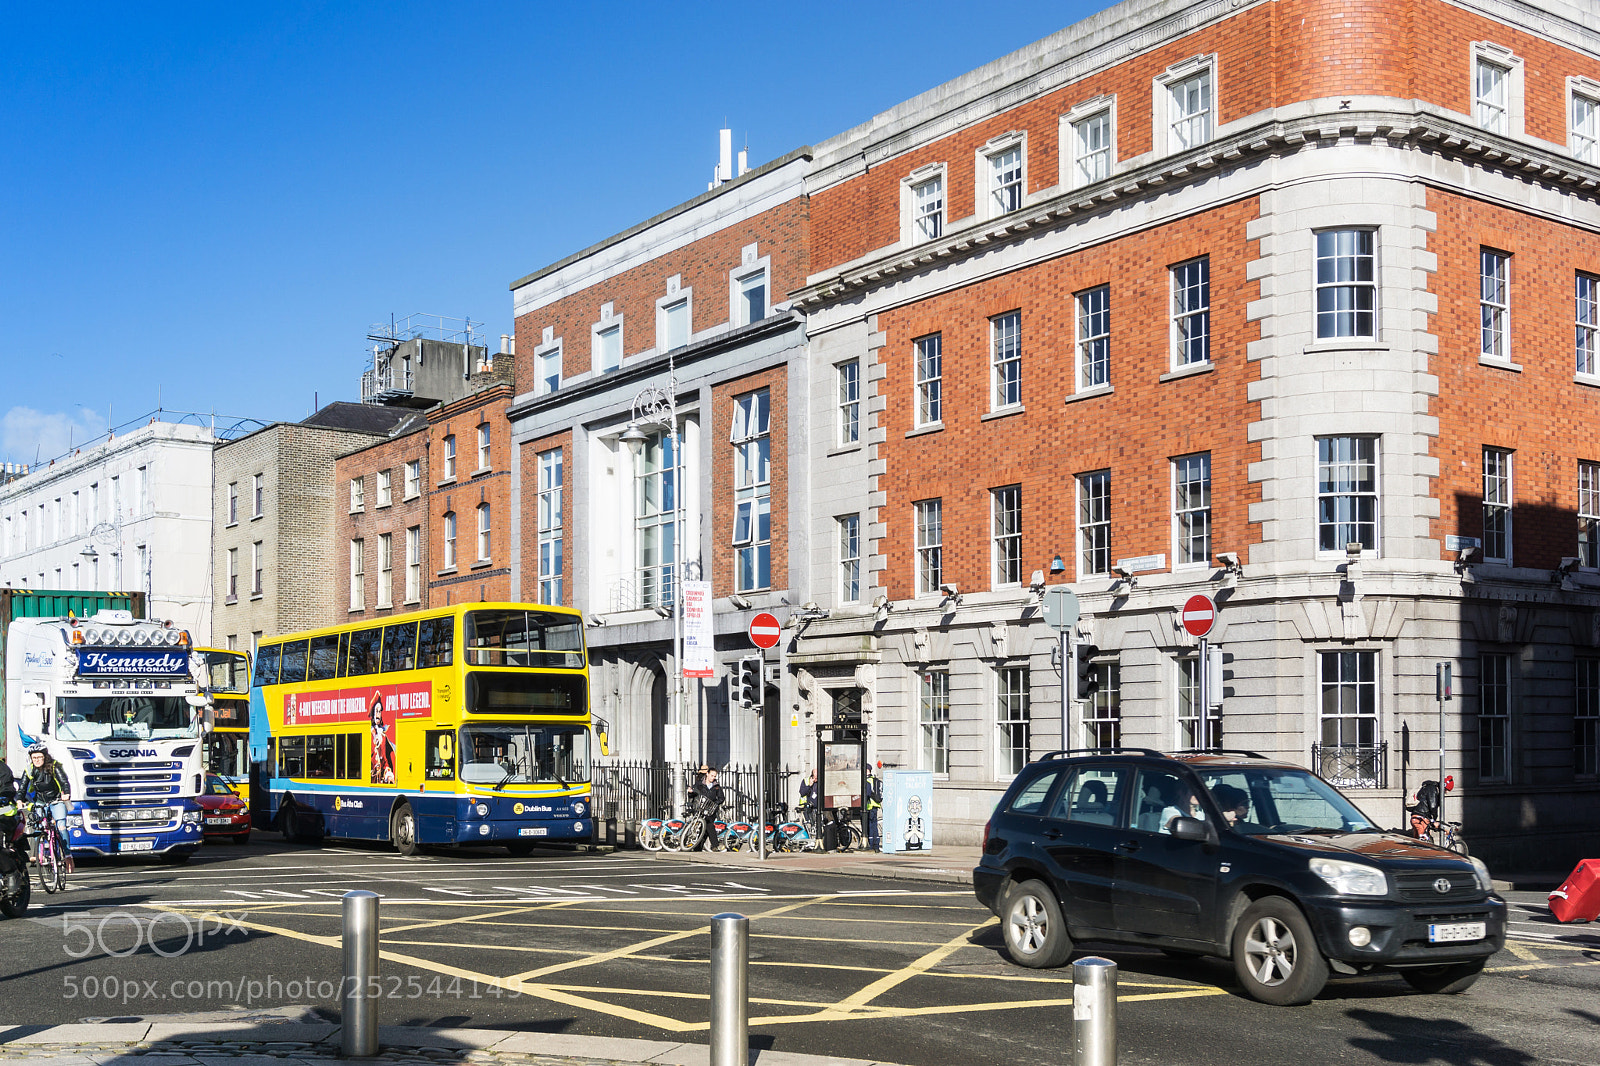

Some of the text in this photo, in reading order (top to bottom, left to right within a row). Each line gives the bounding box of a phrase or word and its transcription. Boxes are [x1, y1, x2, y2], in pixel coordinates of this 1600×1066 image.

[83, 653, 184, 672] Kennedy
[299, 701, 311, 716] 4-DAY
[312, 700, 330, 716] WEEKEND
[331, 699, 337, 715] ON
[346, 696, 367, 713] HORIZON.
[400, 693, 409, 710] YOU
[410, 692, 430, 709] LEGEND.
[109, 749, 158, 758] SCANIA
[421, 881, 772, 897] ENTRY
